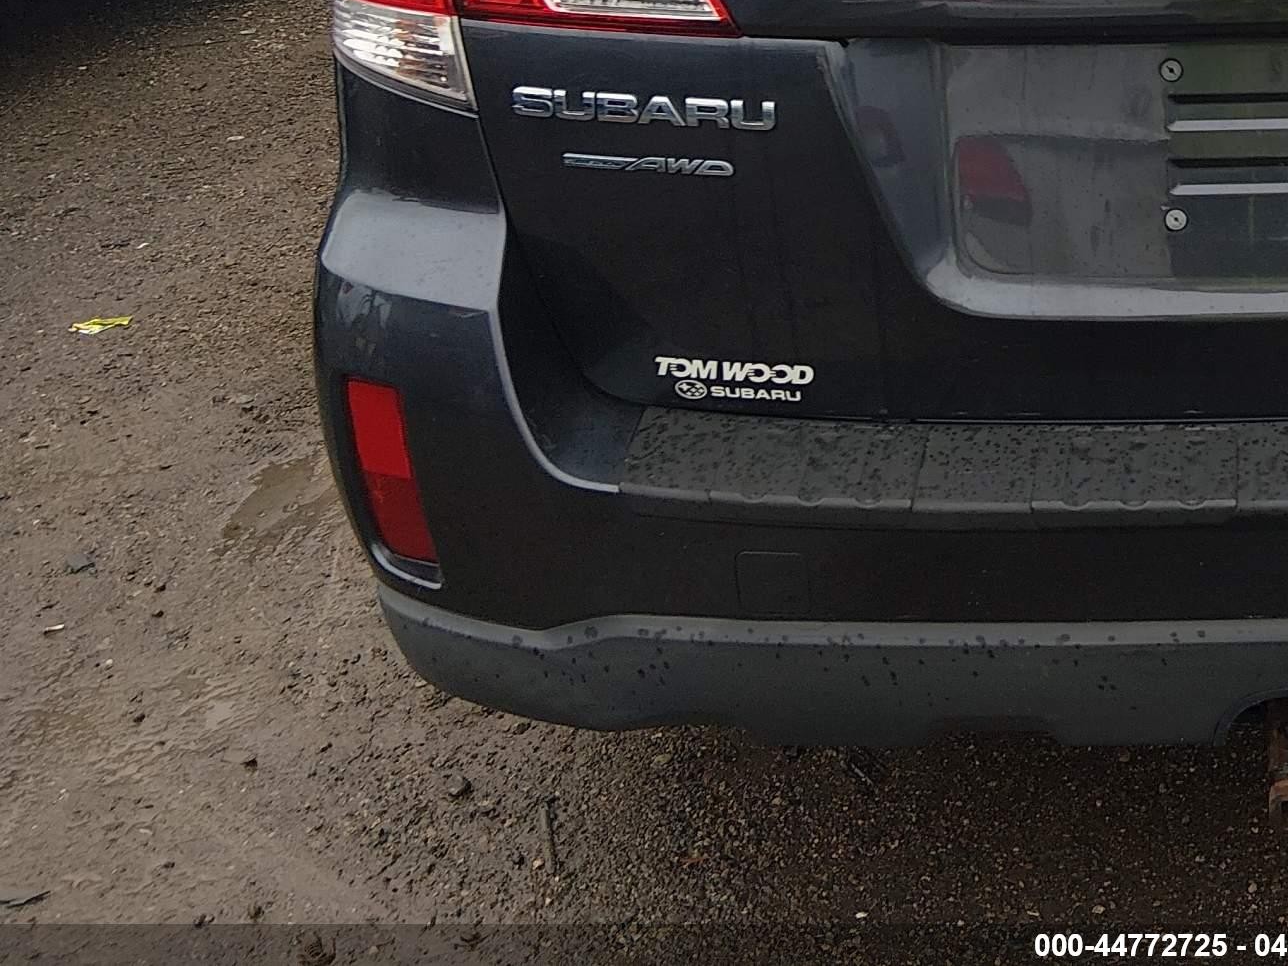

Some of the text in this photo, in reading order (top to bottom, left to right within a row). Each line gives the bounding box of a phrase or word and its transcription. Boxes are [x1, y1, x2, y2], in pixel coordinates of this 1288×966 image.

[512, 86, 776, 131] SUBARU
[625, 156, 735, 177] AWD
[655, 356, 815, 385] TOM WOOD
[710, 385, 802, 402] SUBARU
